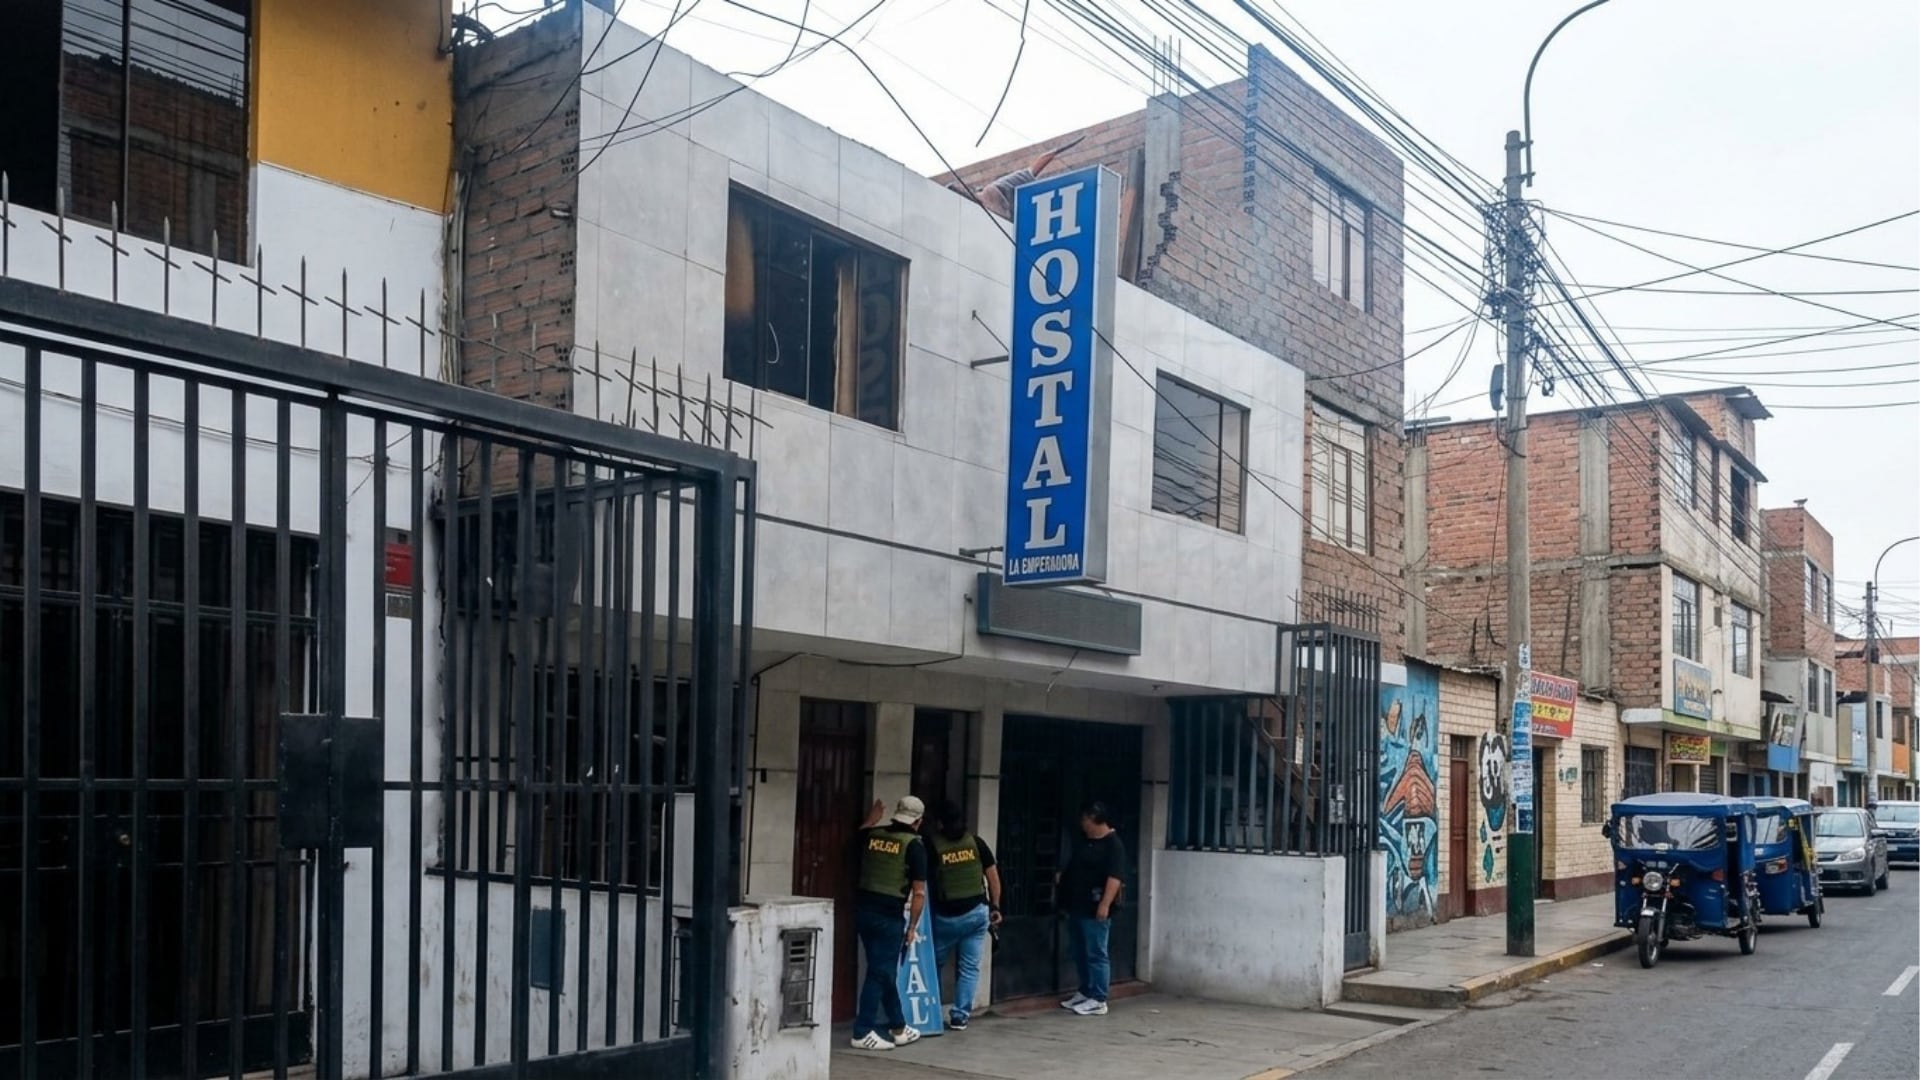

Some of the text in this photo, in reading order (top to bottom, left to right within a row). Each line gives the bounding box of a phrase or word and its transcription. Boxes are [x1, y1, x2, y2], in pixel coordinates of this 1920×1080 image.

[1023, 182, 1084, 550] HOSTAL
[1009, 553, 1080, 576] LA EMPERADORA
